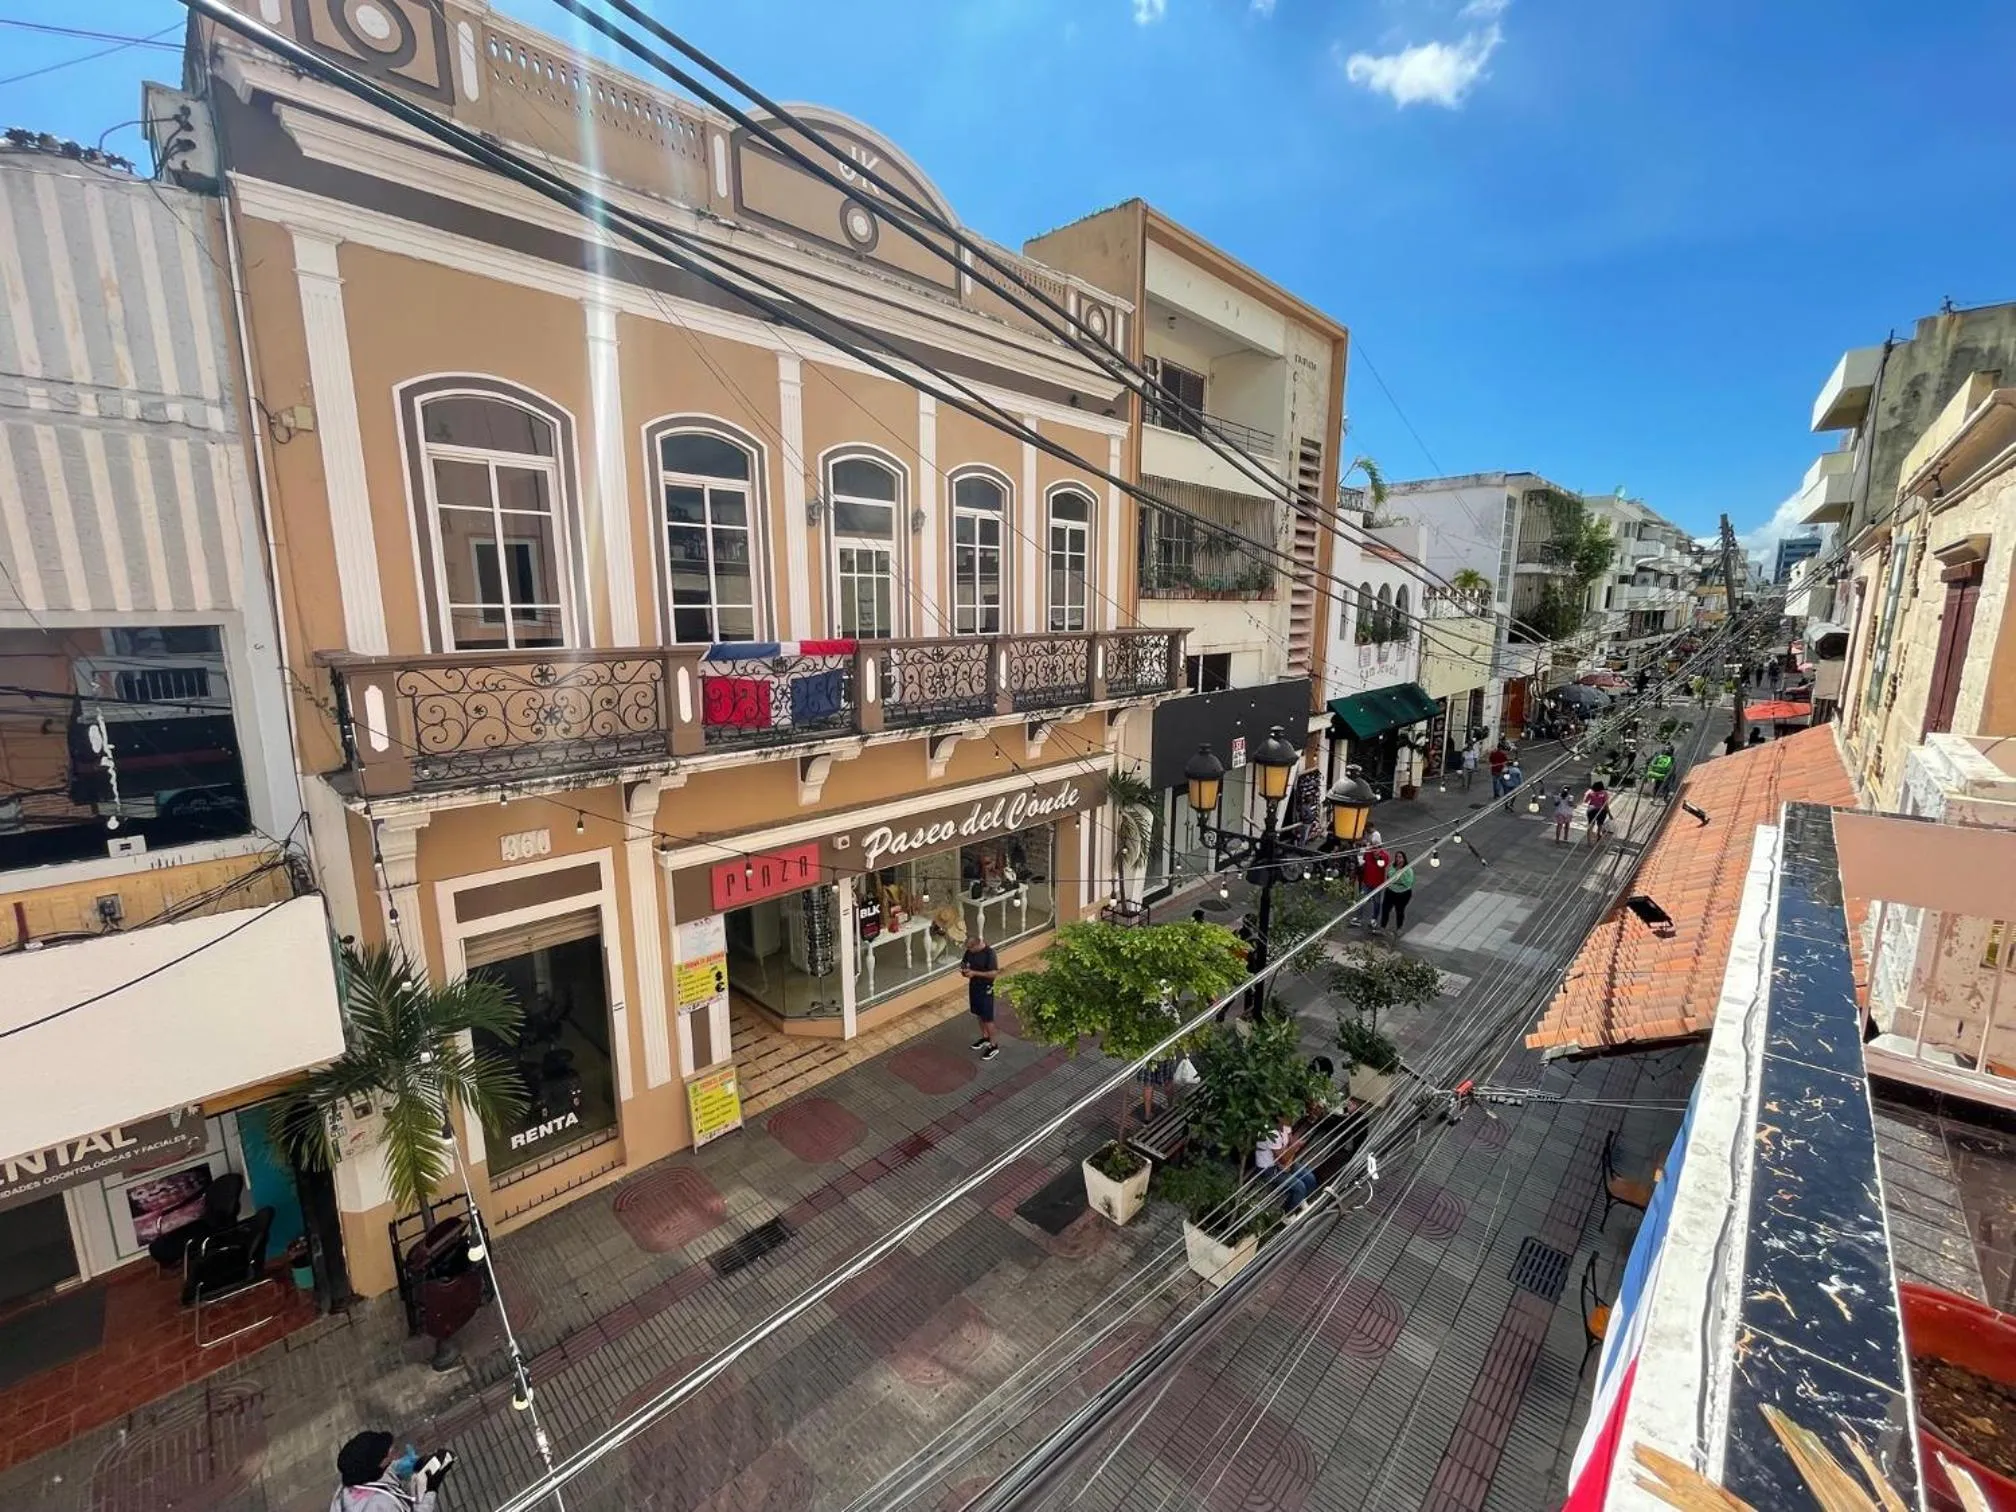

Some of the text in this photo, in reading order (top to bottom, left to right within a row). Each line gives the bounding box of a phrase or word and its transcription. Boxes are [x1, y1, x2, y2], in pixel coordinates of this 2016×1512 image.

[861, 780, 1080, 869] Paseo del Conde
[726, 855, 809, 897] PLAZA
[860, 902, 881, 919] BLK
[141, 1133, 187, 1153] FACIALES
[510, 1111, 579, 1150] RENTA
[0, 1126, 138, 1186] NTAL
